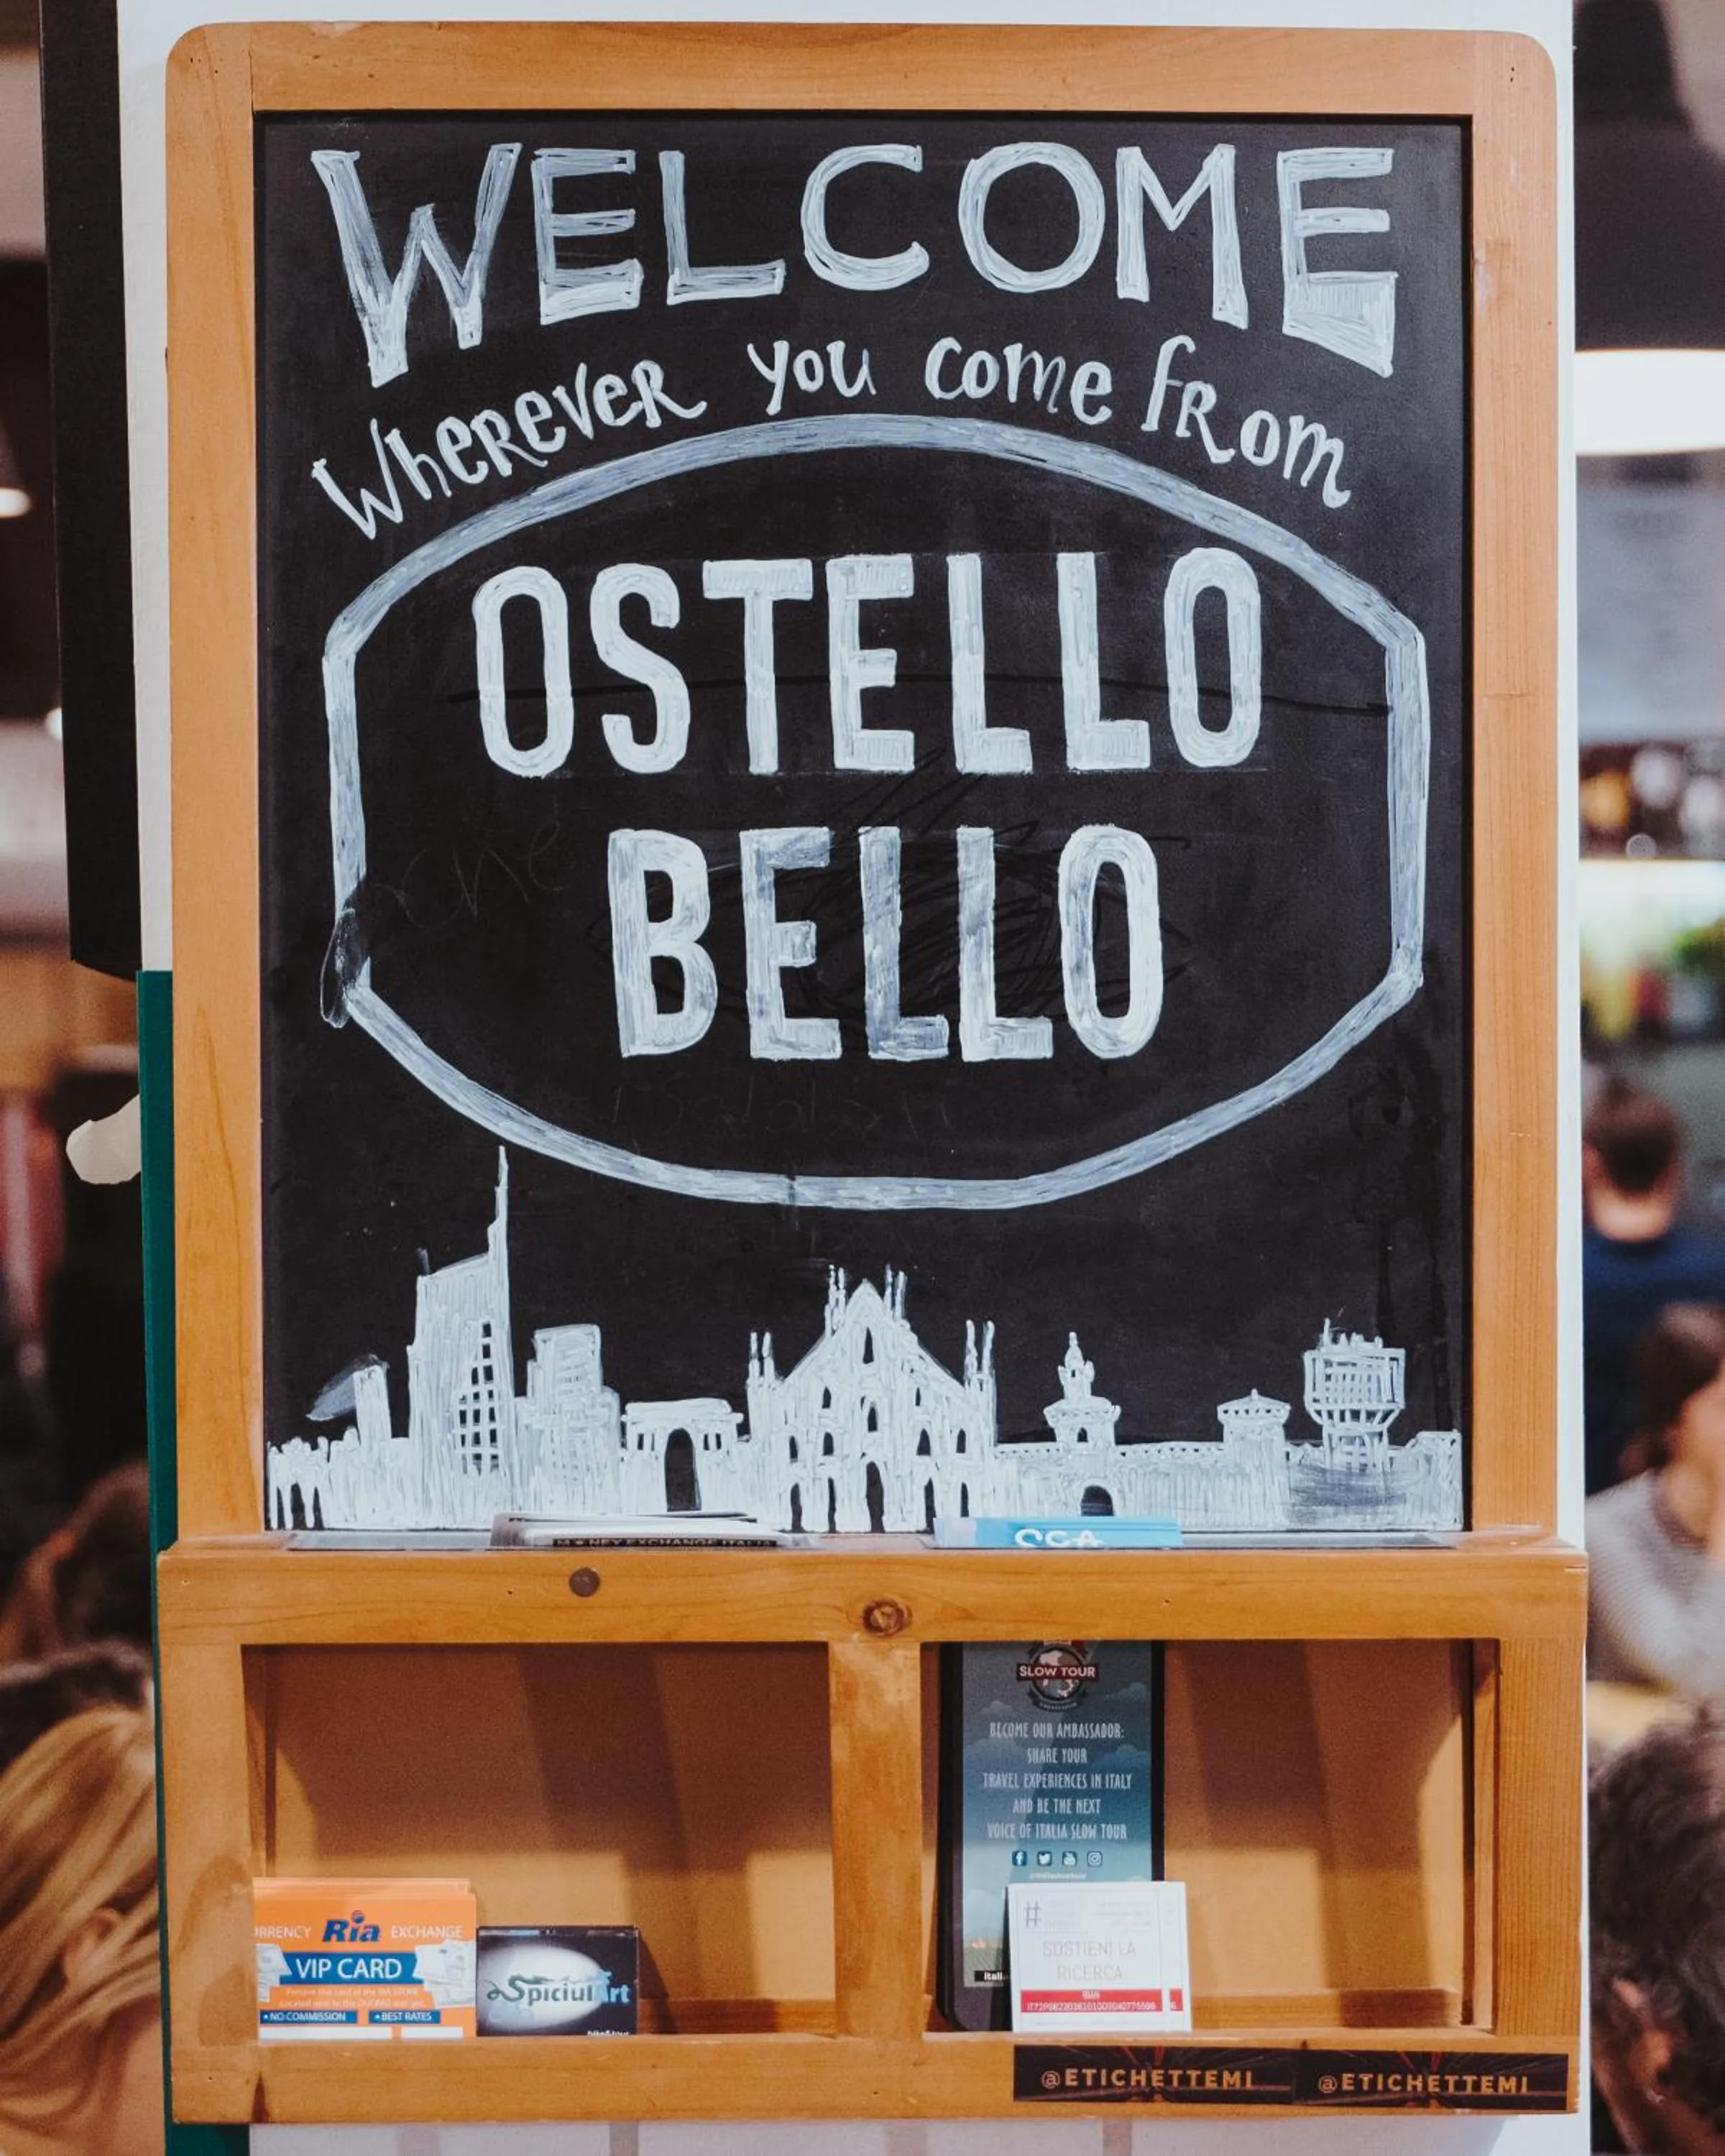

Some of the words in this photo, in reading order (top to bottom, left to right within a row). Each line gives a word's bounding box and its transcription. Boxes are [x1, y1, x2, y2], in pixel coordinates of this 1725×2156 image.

[310, 142, 1398, 389] WELCOME
[747, 339, 875, 415] you
[924, 336, 1113, 425] come
[472, 546, 1263, 778] OSTELLO
[607, 823, 1165, 1063] BELLO
[1019, 1665, 1057, 1677] SLOW
[1060, 1666, 1095, 1678] TOUR
[990, 1722, 1029, 1738] BECOME
[1033, 1722, 1053, 1738] OUR
[1027, 1747, 1058, 1764] SHARE
[1062, 1747, 1087, 1764] YOUR
[983, 1772, 1019, 1788] TRAVEL
[1024, 1772, 1087, 1789] EXPERIENCES
[1090, 1772, 1102, 1789] IN
[1105, 1772, 1132, 1789] ITALY
[1013, 1798, 1033, 1814] AND
[1037, 1798, 1049, 1814] BE
[1054, 1798, 1072, 1815] THE
[1076, 1798, 1101, 1815] NEXT
[987, 1823, 1016, 1838] VOICE
[1021, 1823, 1032, 1838] OF
[1036, 1823, 1067, 1839] ITALIA
[1071, 1823, 1097, 1839] SLOW
[1101, 1823, 1127, 1839] TOUR
[321, 1909, 381, 1943] Ria
[391, 1925, 463, 1939] EXCHANGE
[1042, 1940, 1113, 1957] SOSTIENI
[1118, 1940, 1136, 1957] LA
[295, 1958, 331, 1978] VIP
[337, 1958, 402, 1978] CARD
[1057, 1964, 1123, 1981] RICERCA
[270, 2012, 285, 2022] NO
[288, 2012, 346, 2022] COMMISSION
[382, 2012, 402, 2022] BEST
[405, 2012, 432, 2022] RATES
[1041, 2068, 1253, 2089] @ETICHETTEMI
[1317, 2073, 1528, 2094] @ETICHETTEMI
